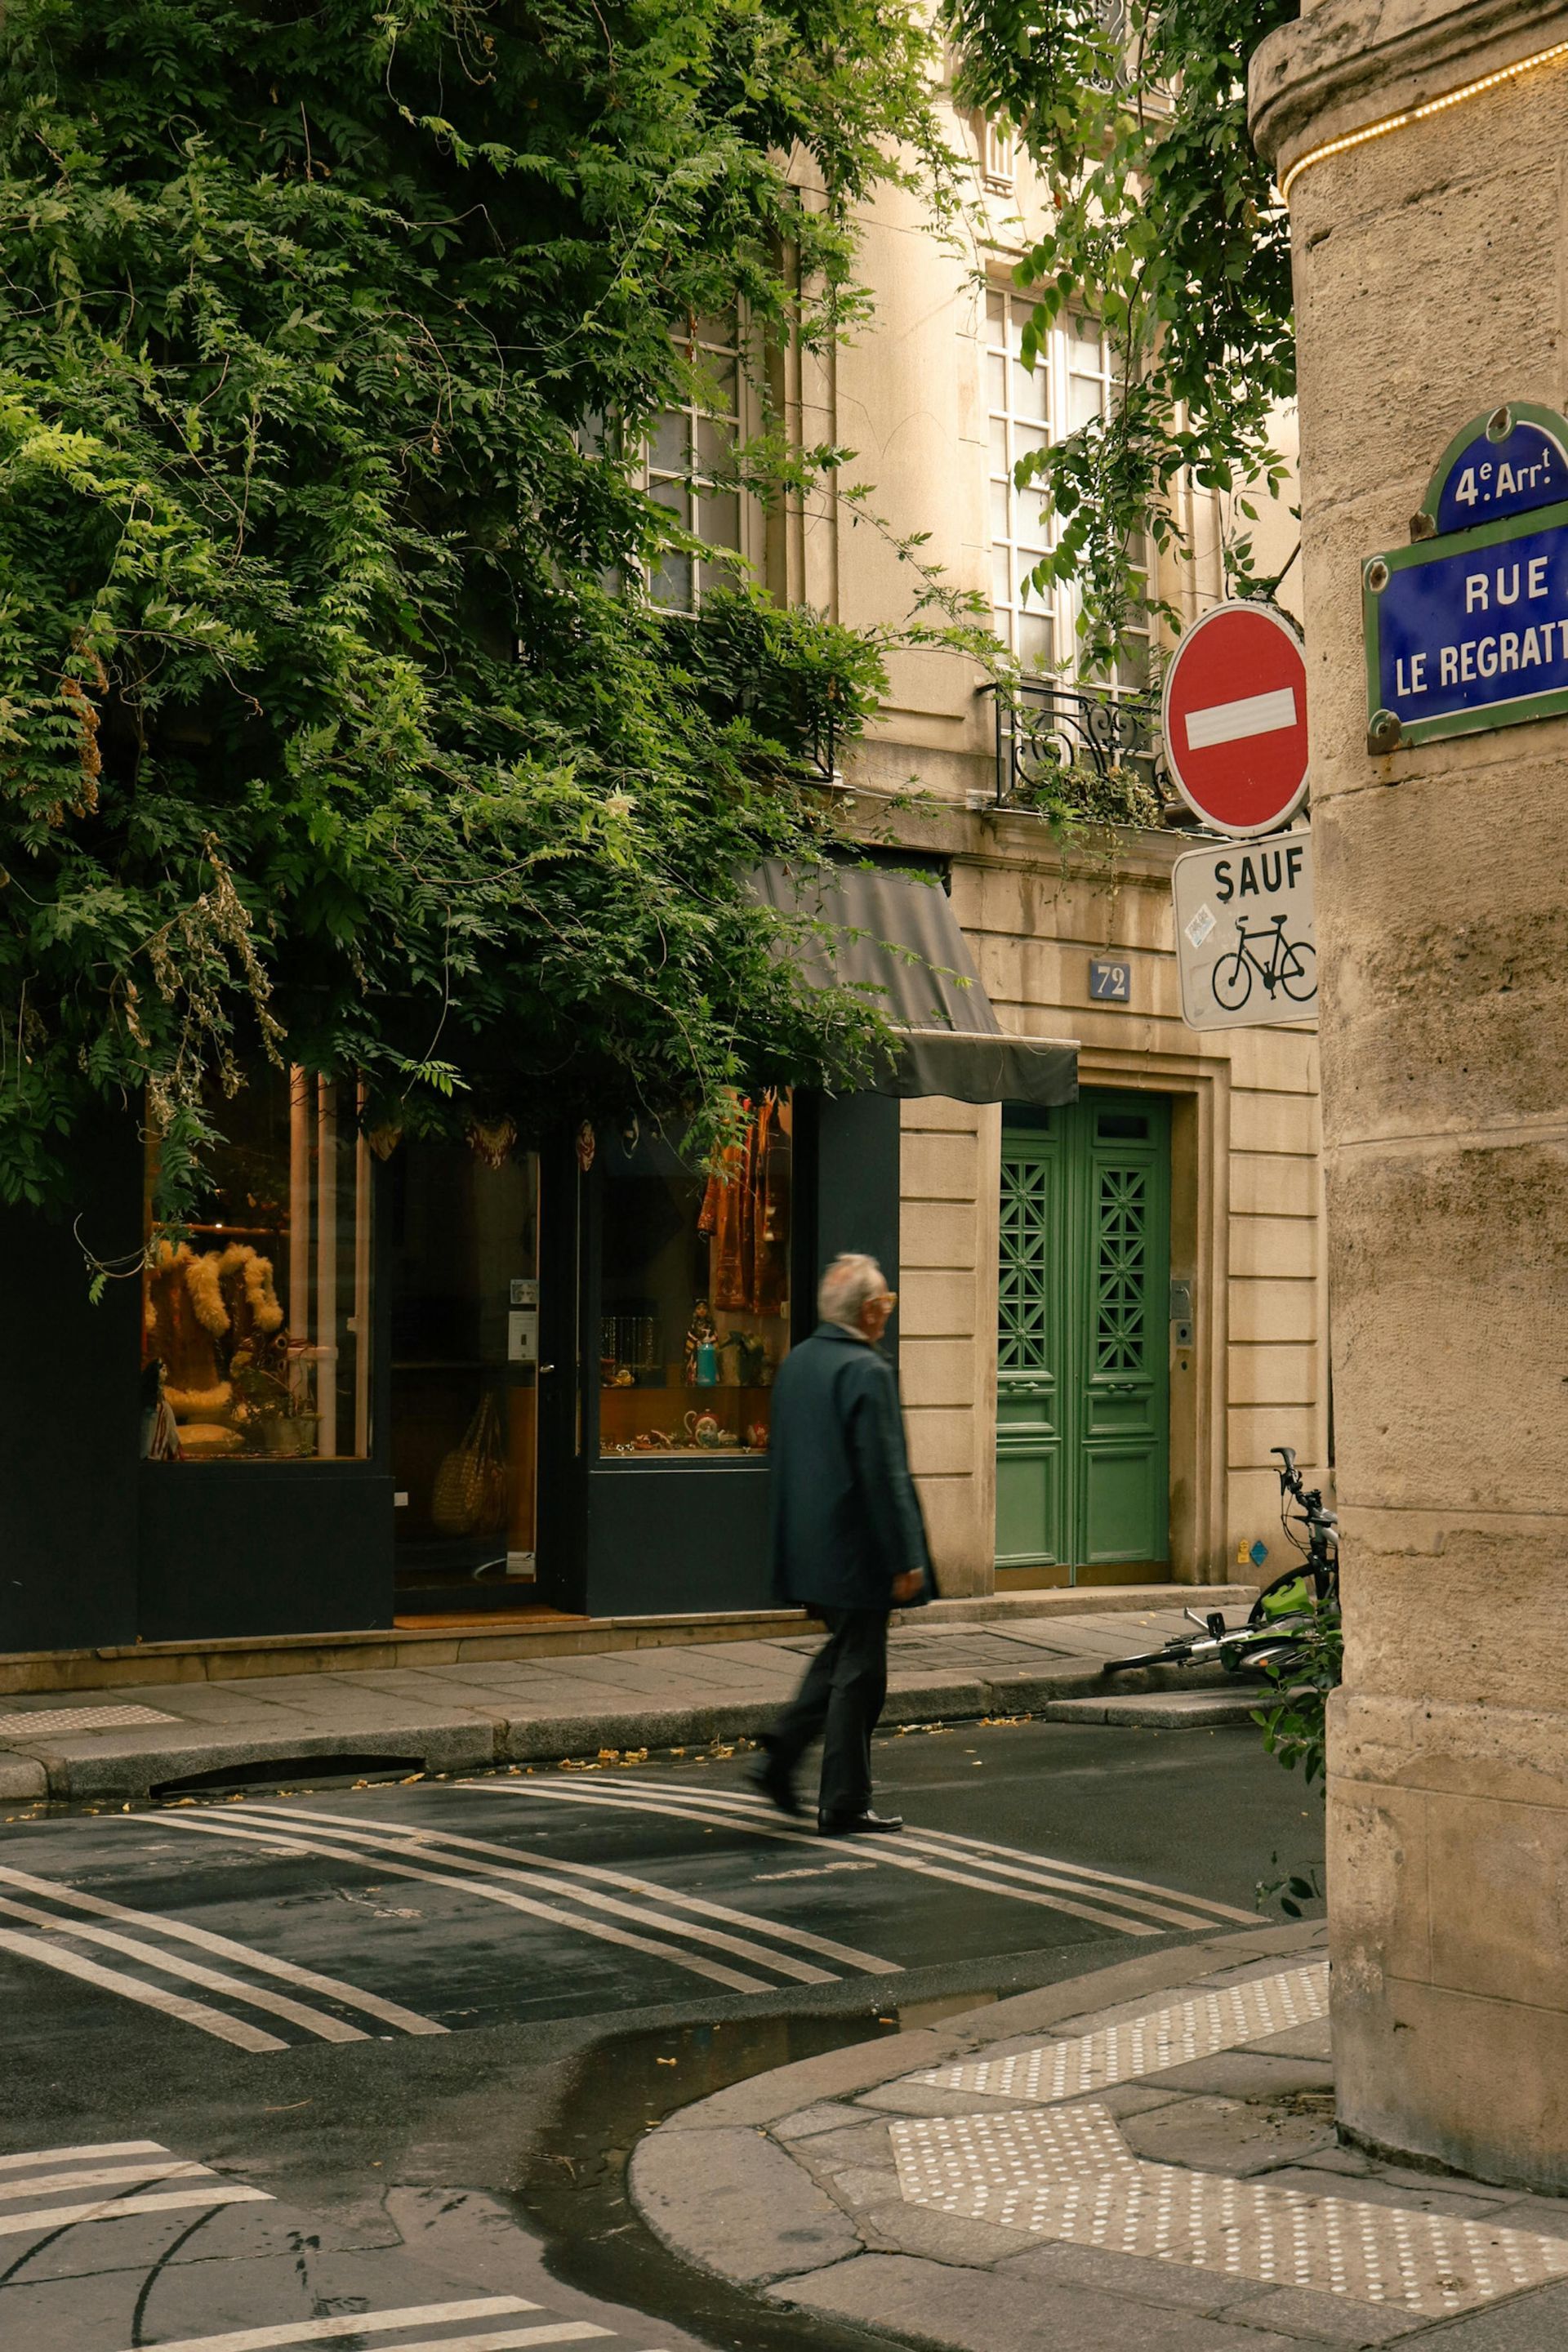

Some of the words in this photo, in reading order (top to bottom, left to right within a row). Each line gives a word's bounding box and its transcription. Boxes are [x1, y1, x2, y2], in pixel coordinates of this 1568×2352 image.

[1465, 555, 1549, 613] RUE
[1396, 653, 1428, 697] LE
[1214, 846, 1303, 901] SAUF
[1098, 965, 1125, 995] 72
